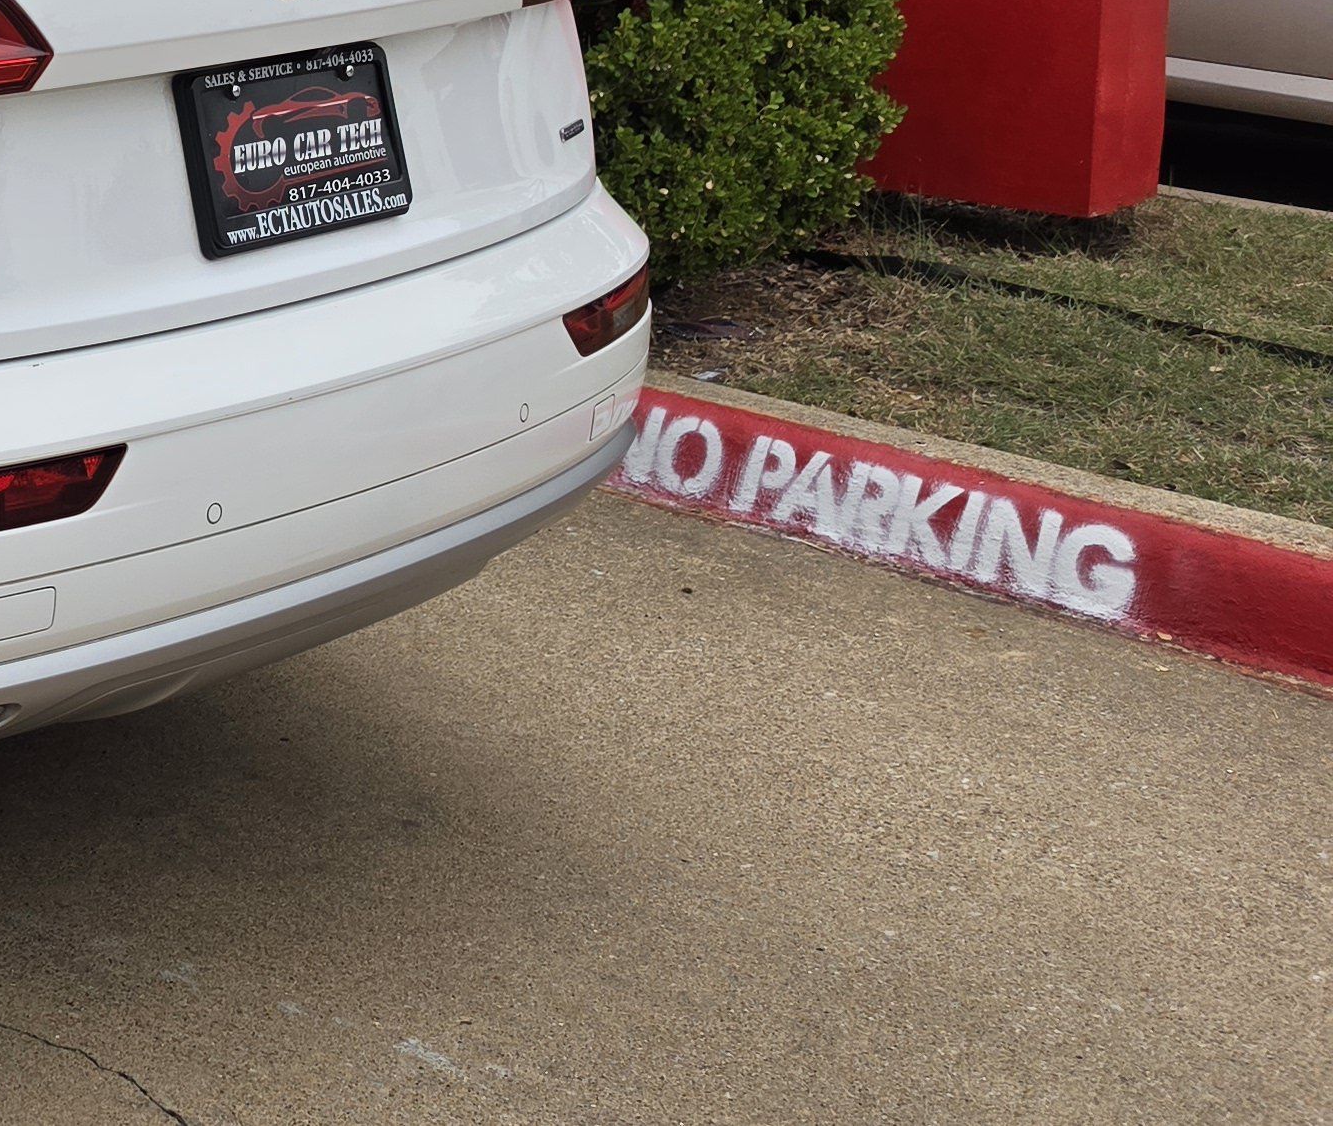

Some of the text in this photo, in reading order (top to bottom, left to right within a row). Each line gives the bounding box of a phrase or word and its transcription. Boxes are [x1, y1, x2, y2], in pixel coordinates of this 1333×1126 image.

[204, 48, 374, 89] SALES & SERVICE 817-404-4033
[233, 118, 383, 174] EURO CAR TECH
[284, 145, 387, 178] european automotive
[288, 168, 391, 202] 817-404-4033
[227, 188, 408, 245] www.ECTAUTOSALES.com
[622, 405, 1138, 622] NO PARKING
